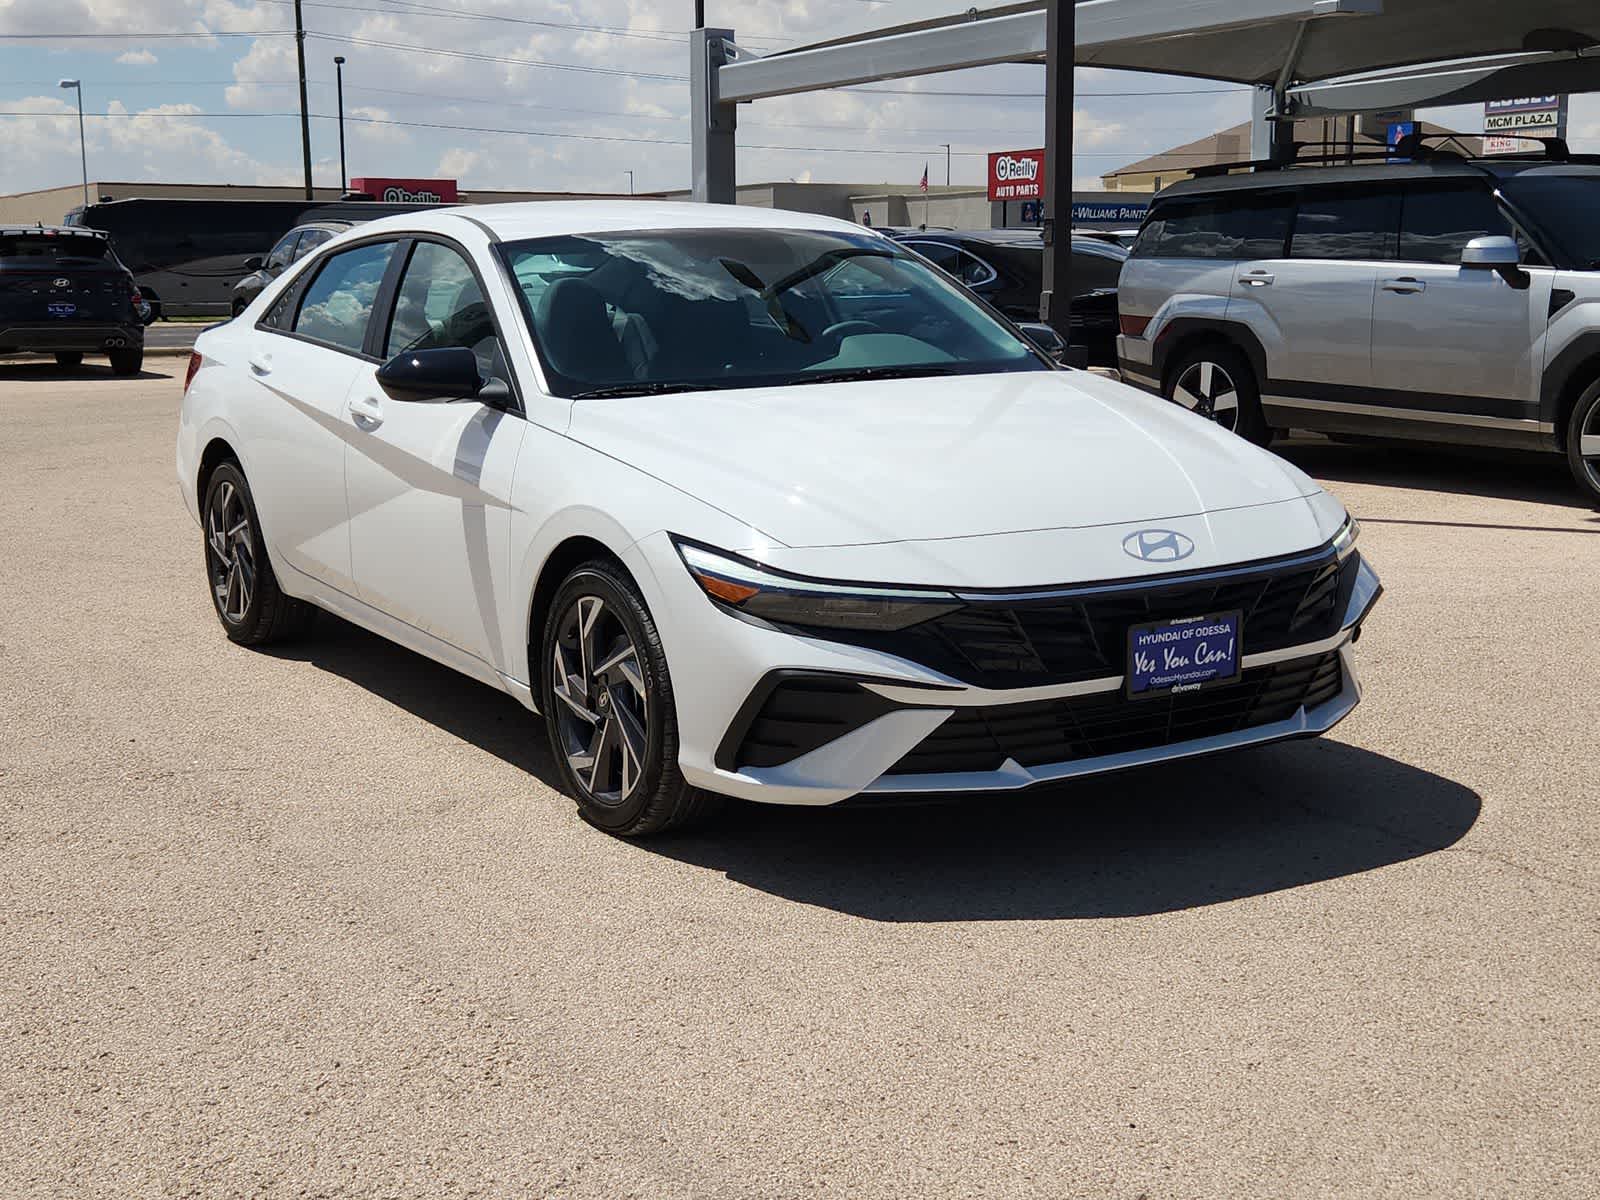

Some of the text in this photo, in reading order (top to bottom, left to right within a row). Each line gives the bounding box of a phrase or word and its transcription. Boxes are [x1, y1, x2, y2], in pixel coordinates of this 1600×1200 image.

[1487, 113, 1553, 128] MCM PLAZA
[996, 156, 1038, 181] O'Reilly
[996, 184, 1039, 198] AUTO PARTS
[1138, 623, 1231, 646] HYUNDAI OF ODESSA
[1134, 636, 1234, 675] Yes You Can!
